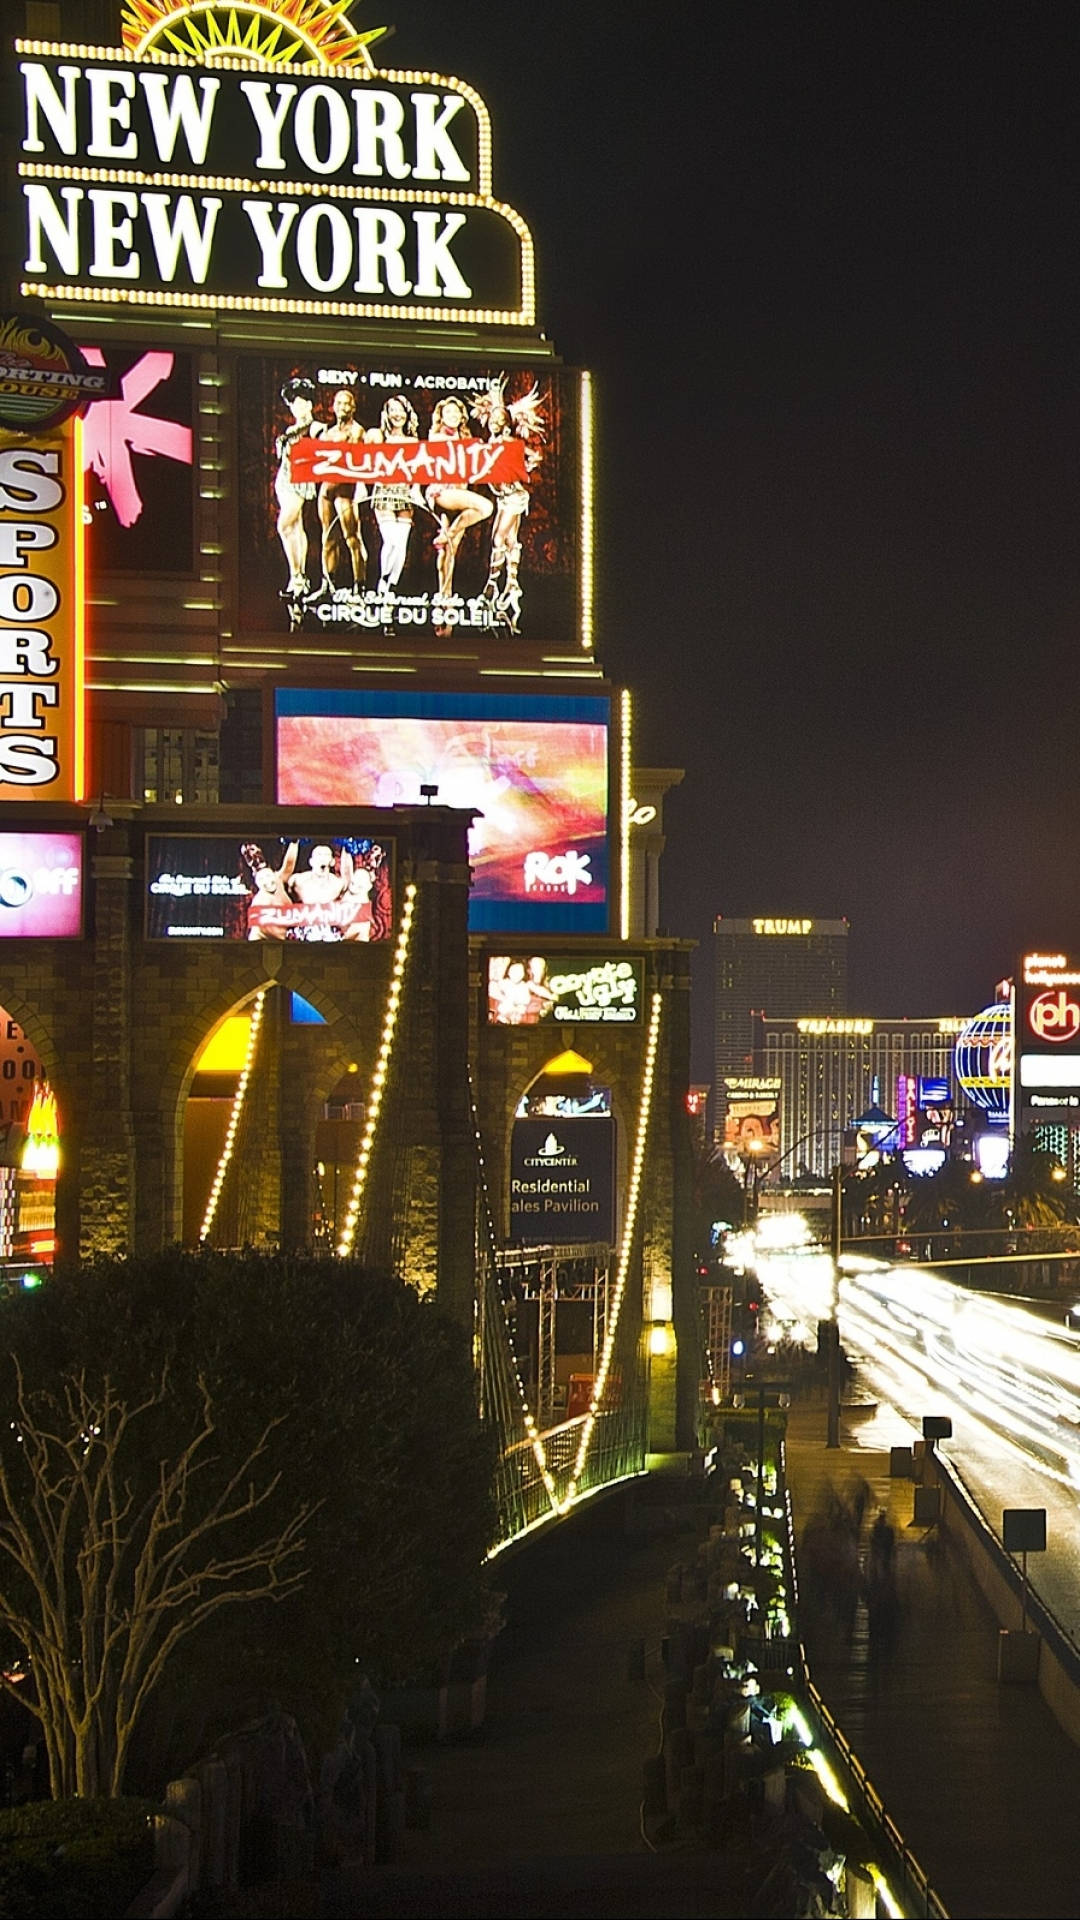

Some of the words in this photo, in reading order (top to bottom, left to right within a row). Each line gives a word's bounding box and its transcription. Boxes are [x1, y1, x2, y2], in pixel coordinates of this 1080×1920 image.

[19, 63, 220, 164] NEW
[241, 81, 471, 182] YORK
[23, 184, 222, 283] NEW
[242, 200, 472, 298] YORK
[318, 370, 358, 385] SEXY
[370, 373, 401, 388] FUN
[414, 376, 502, 391] ACROBATIC
[311, 440, 505, 484] ZUMANITY
[0, 449, 64, 786] SPORTS
[316, 604, 394, 628] CIRQUE
[398, 607, 428, 625] DU
[752, 919, 813, 935] TRUMP
[1036, 992, 1080, 1036] ph
[511, 1179, 590, 1194] Residential
[544, 1200, 599, 1213] Pavilion
